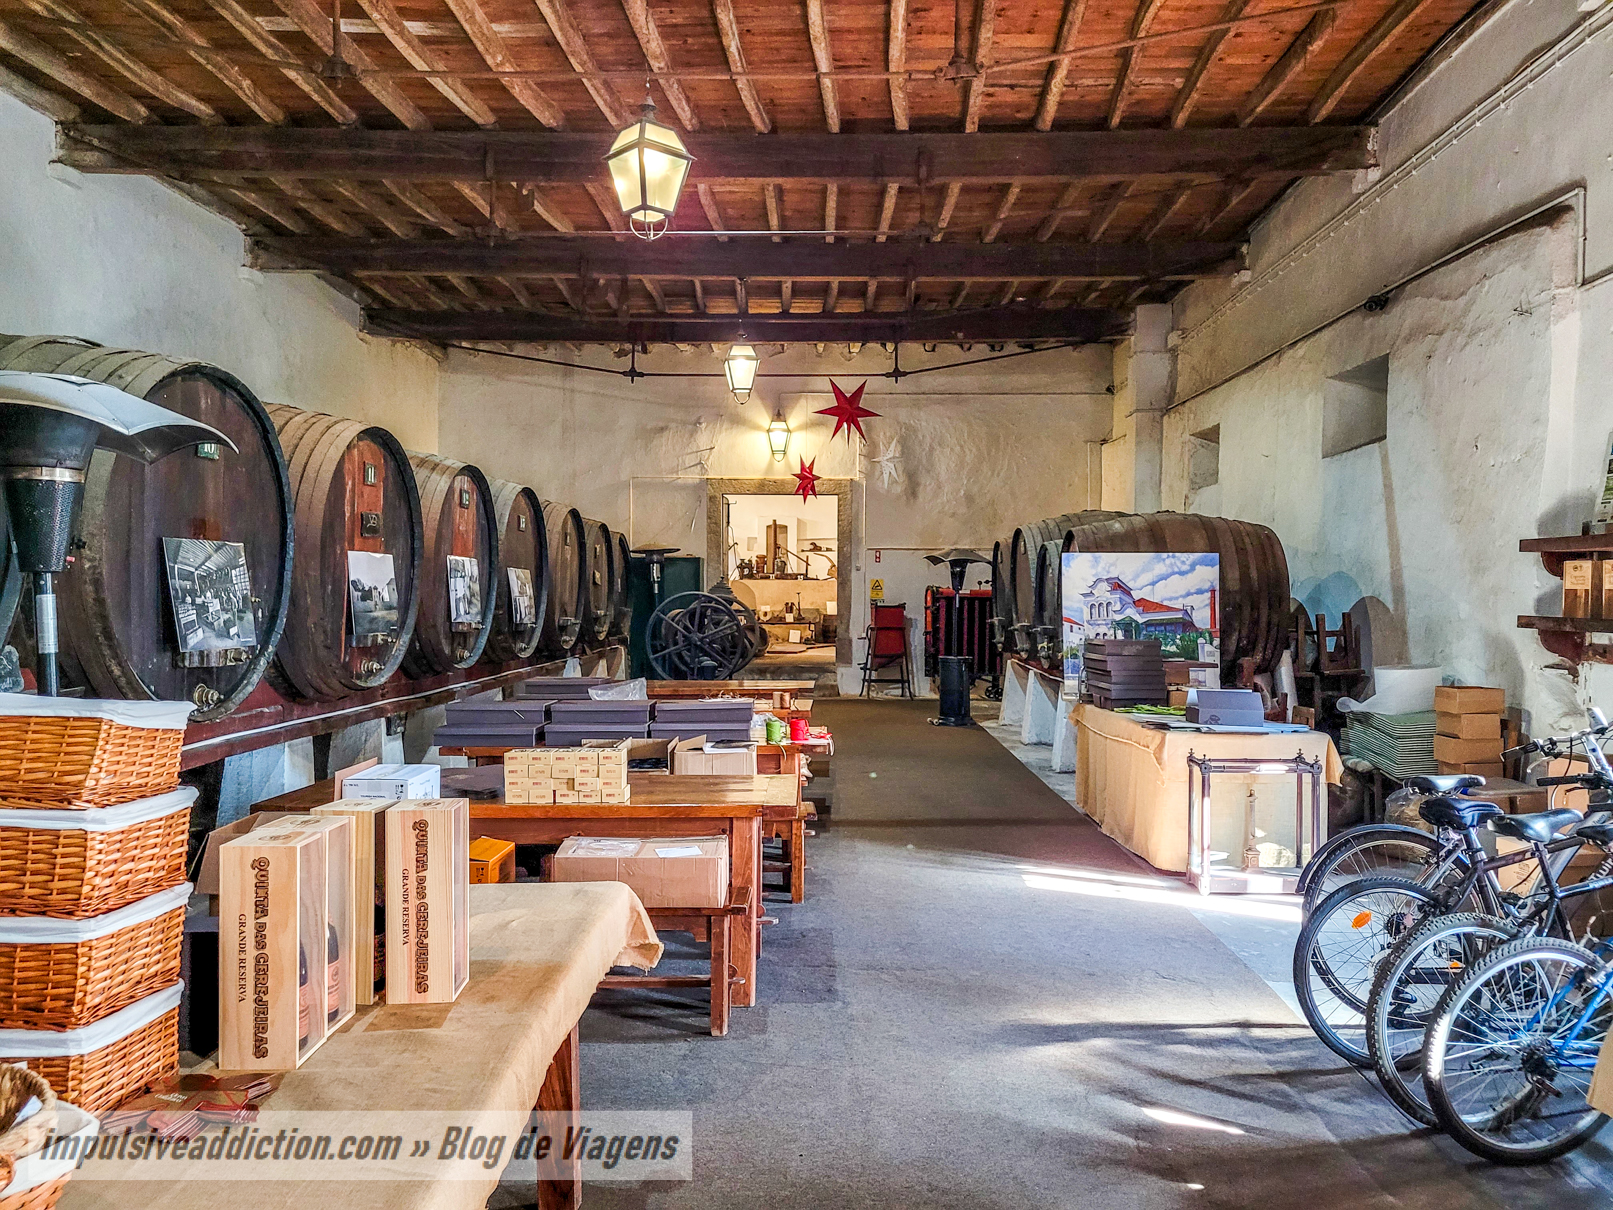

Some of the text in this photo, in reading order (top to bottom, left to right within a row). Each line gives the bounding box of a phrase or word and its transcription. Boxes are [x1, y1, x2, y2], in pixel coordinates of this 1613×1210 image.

[238, 913, 247, 1003] GRANDE RESERVA
[250, 857, 270, 1059] QUINTA DAS CEREJEIRAS
[402, 868, 410, 946] GRANDE RESERVA
[412, 819, 429, 994] QUINTA DAS CEREJEIRAS
